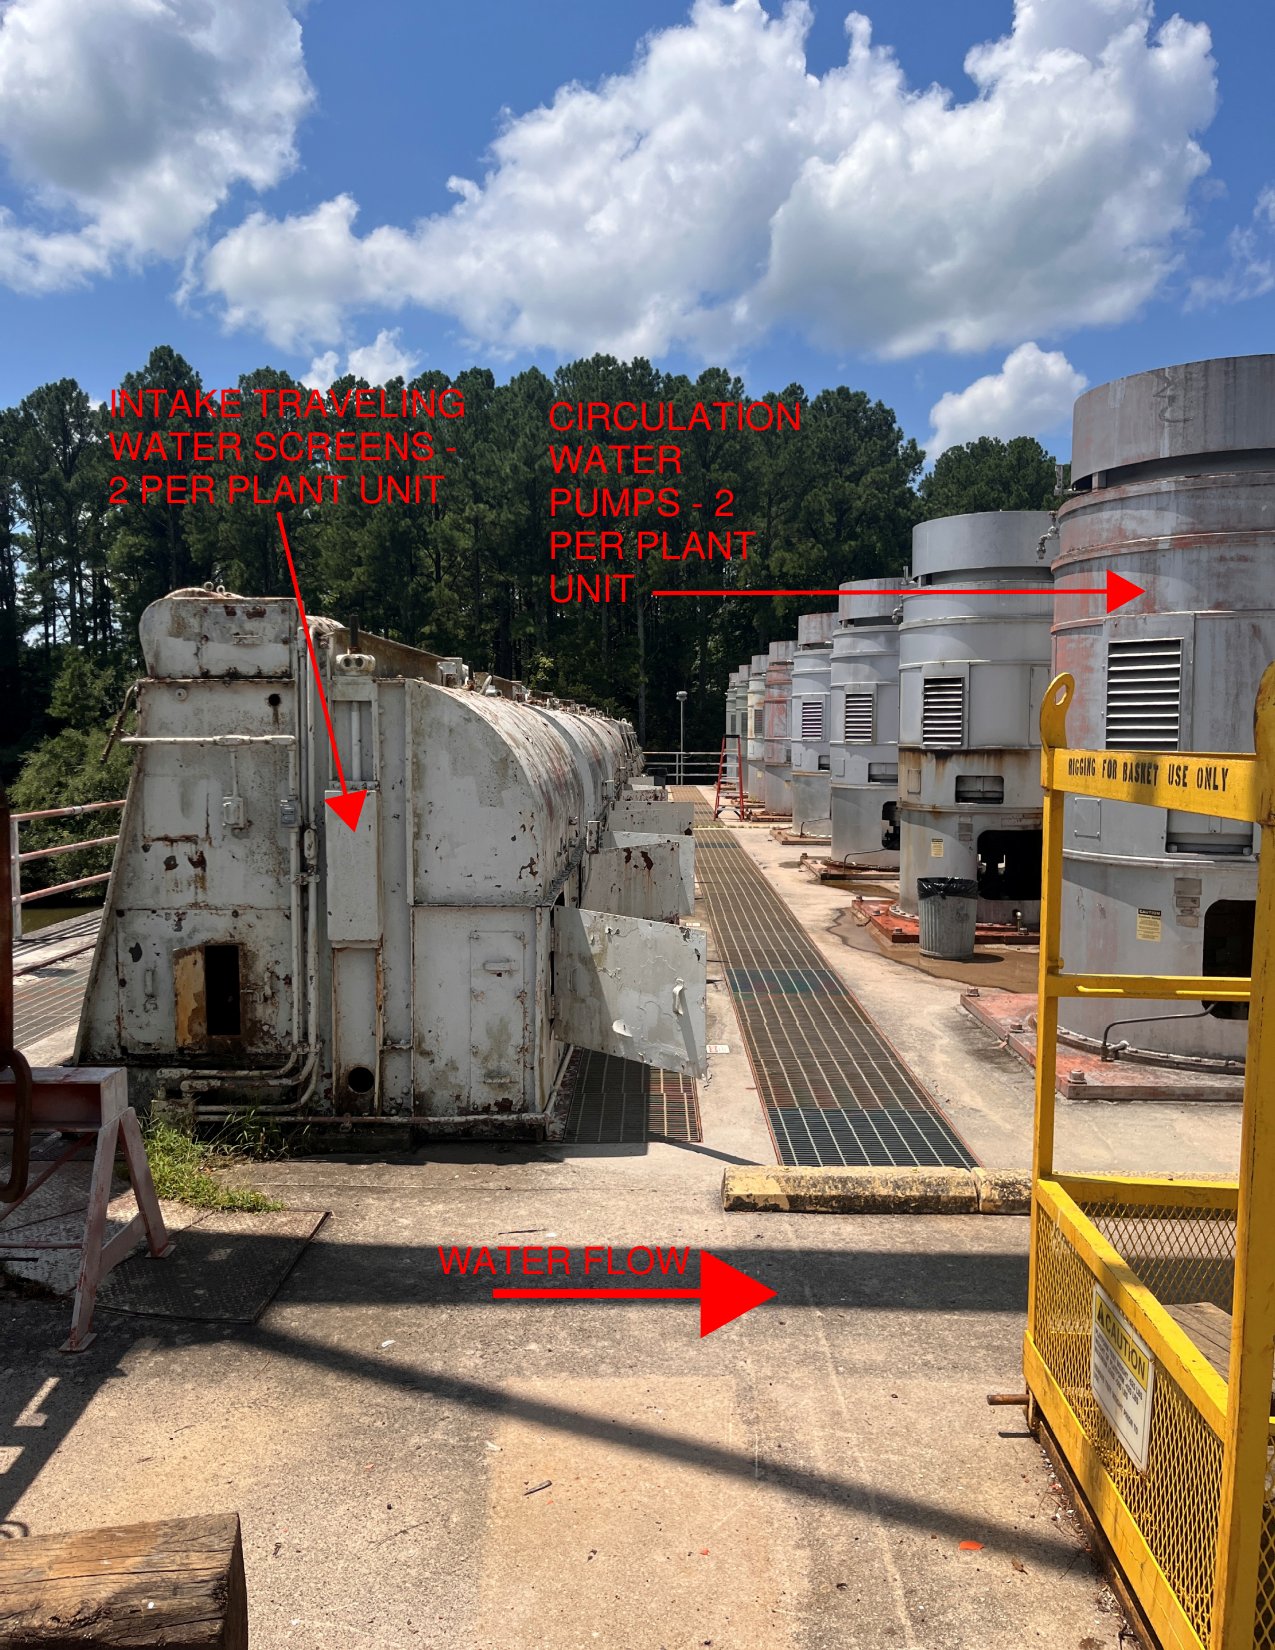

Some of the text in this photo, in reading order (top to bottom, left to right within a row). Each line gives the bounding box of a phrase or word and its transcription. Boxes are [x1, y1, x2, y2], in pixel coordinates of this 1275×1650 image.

[1068, 757, 1229, 792] RIGGING FOR BASKET USE ONLY
[1104, 1314, 1146, 1381] CAUTION
